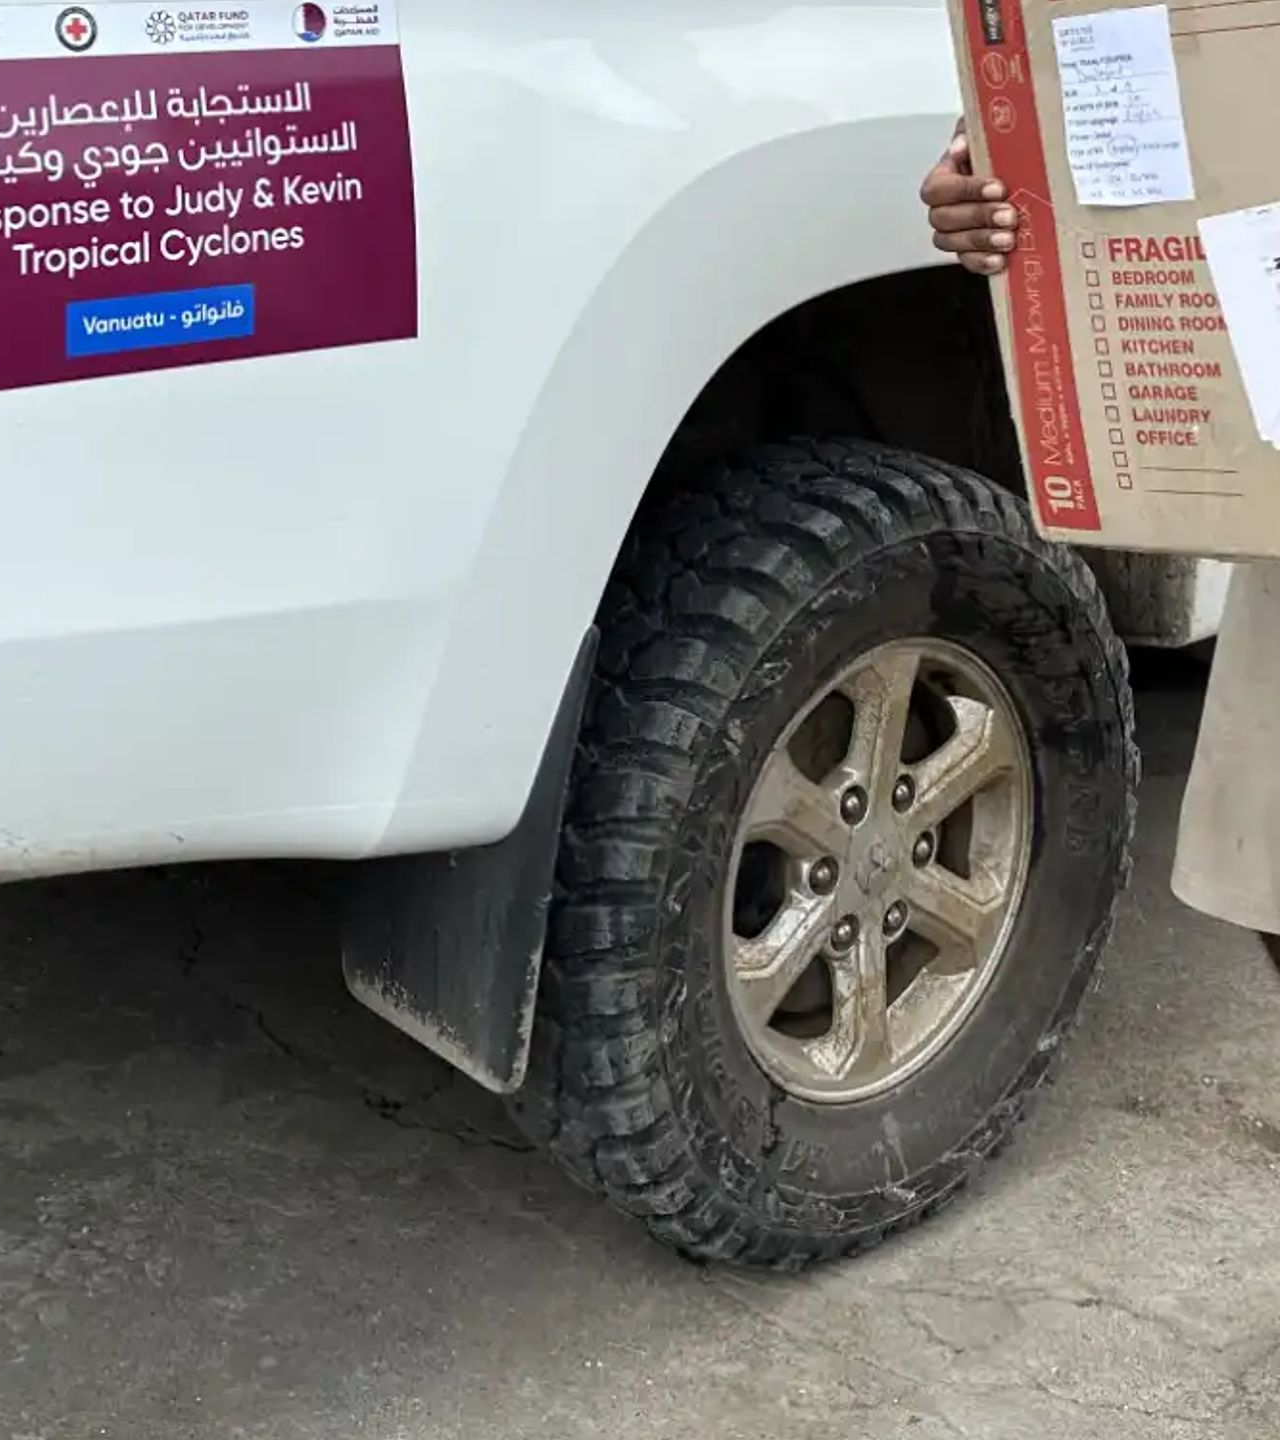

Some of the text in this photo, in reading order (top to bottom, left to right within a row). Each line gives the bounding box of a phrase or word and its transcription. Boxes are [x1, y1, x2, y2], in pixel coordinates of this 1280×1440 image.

[178, 9, 250, 23] QATAR FUND
[166, 81, 312, 126] الاستجابة
[177, 121, 358, 171] الاستوائيين
[73, 139, 169, 188] جودي
[119, 192, 155, 219] to
[165, 183, 243, 219] Judy
[251, 178, 274, 209] &
[283, 173, 363, 206] Kevin
[1016, 202, 1037, 252] Box
[12, 224, 305, 279] Tropical Cyclones
[1107, 236, 1208, 262] FRAGIL
[1111, 270, 1195, 286] BEDROOM
[1022, 258, 1048, 353] Moving
[1115, 293, 1220, 309] FAMILY ROO
[82, 311, 165, 335] Vanuatu
[181, 302, 245, 329] فانواتو
[1117, 316, 1175, 332] DINING
[1121, 339, 1195, 354] KITCHEN
[1124, 362, 1222, 378] BATHROOM
[1128, 385, 1199, 401] GARAGE
[1033, 360, 1063, 466] Medium
[1131, 407, 1211, 423] LAUNDRY
[1135, 429, 1198, 446] OFFICE
[1043, 475, 1075, 514] 10
[1072, 479, 1087, 511] PACK
